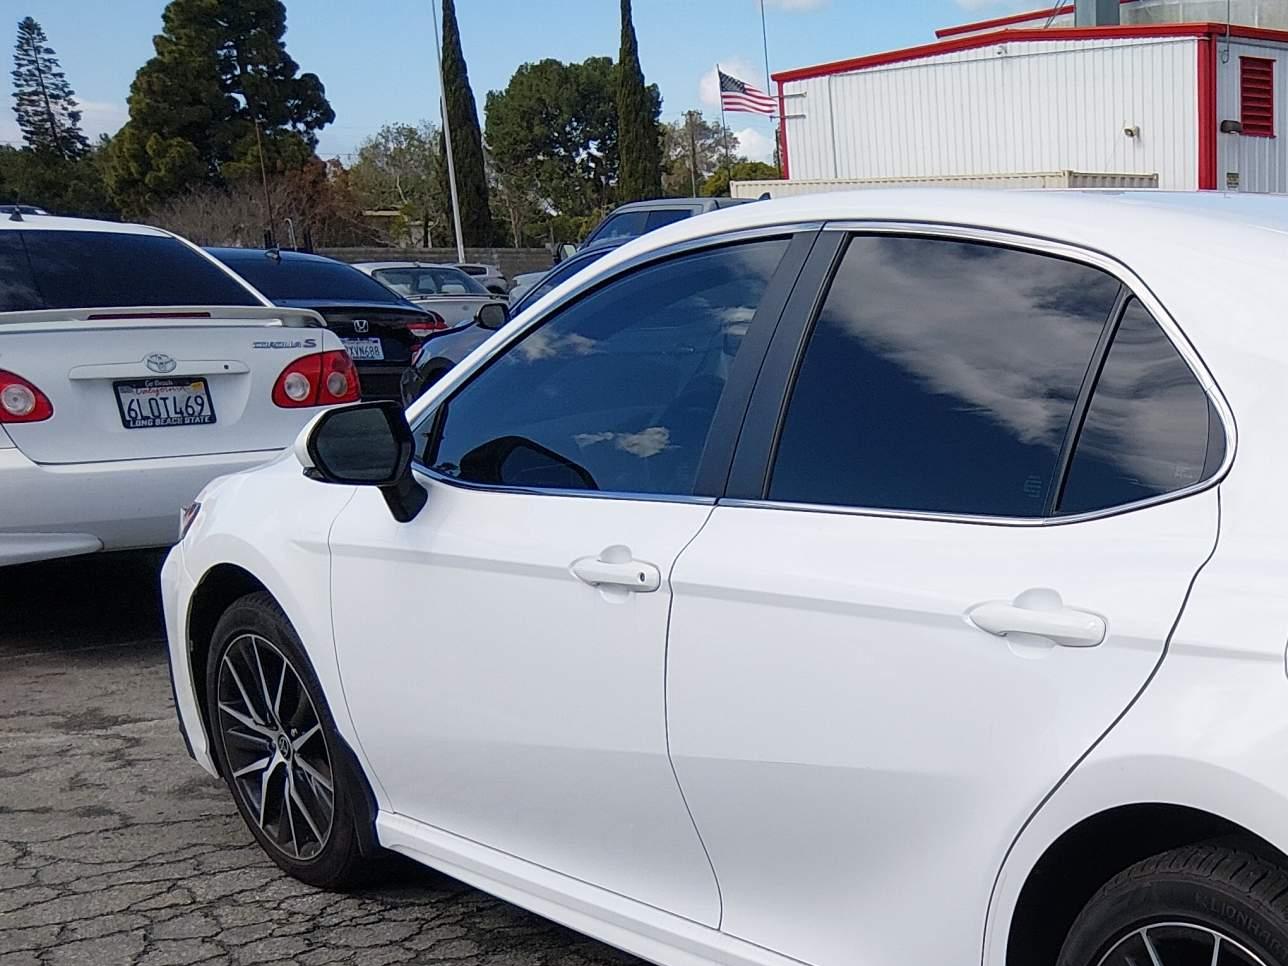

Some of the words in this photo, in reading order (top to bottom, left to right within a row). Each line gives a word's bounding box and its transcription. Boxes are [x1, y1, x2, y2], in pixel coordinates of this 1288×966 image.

[303, 338, 317, 348] S
[344, 345, 380, 357] XVN688
[130, 419, 153, 427] LONG
